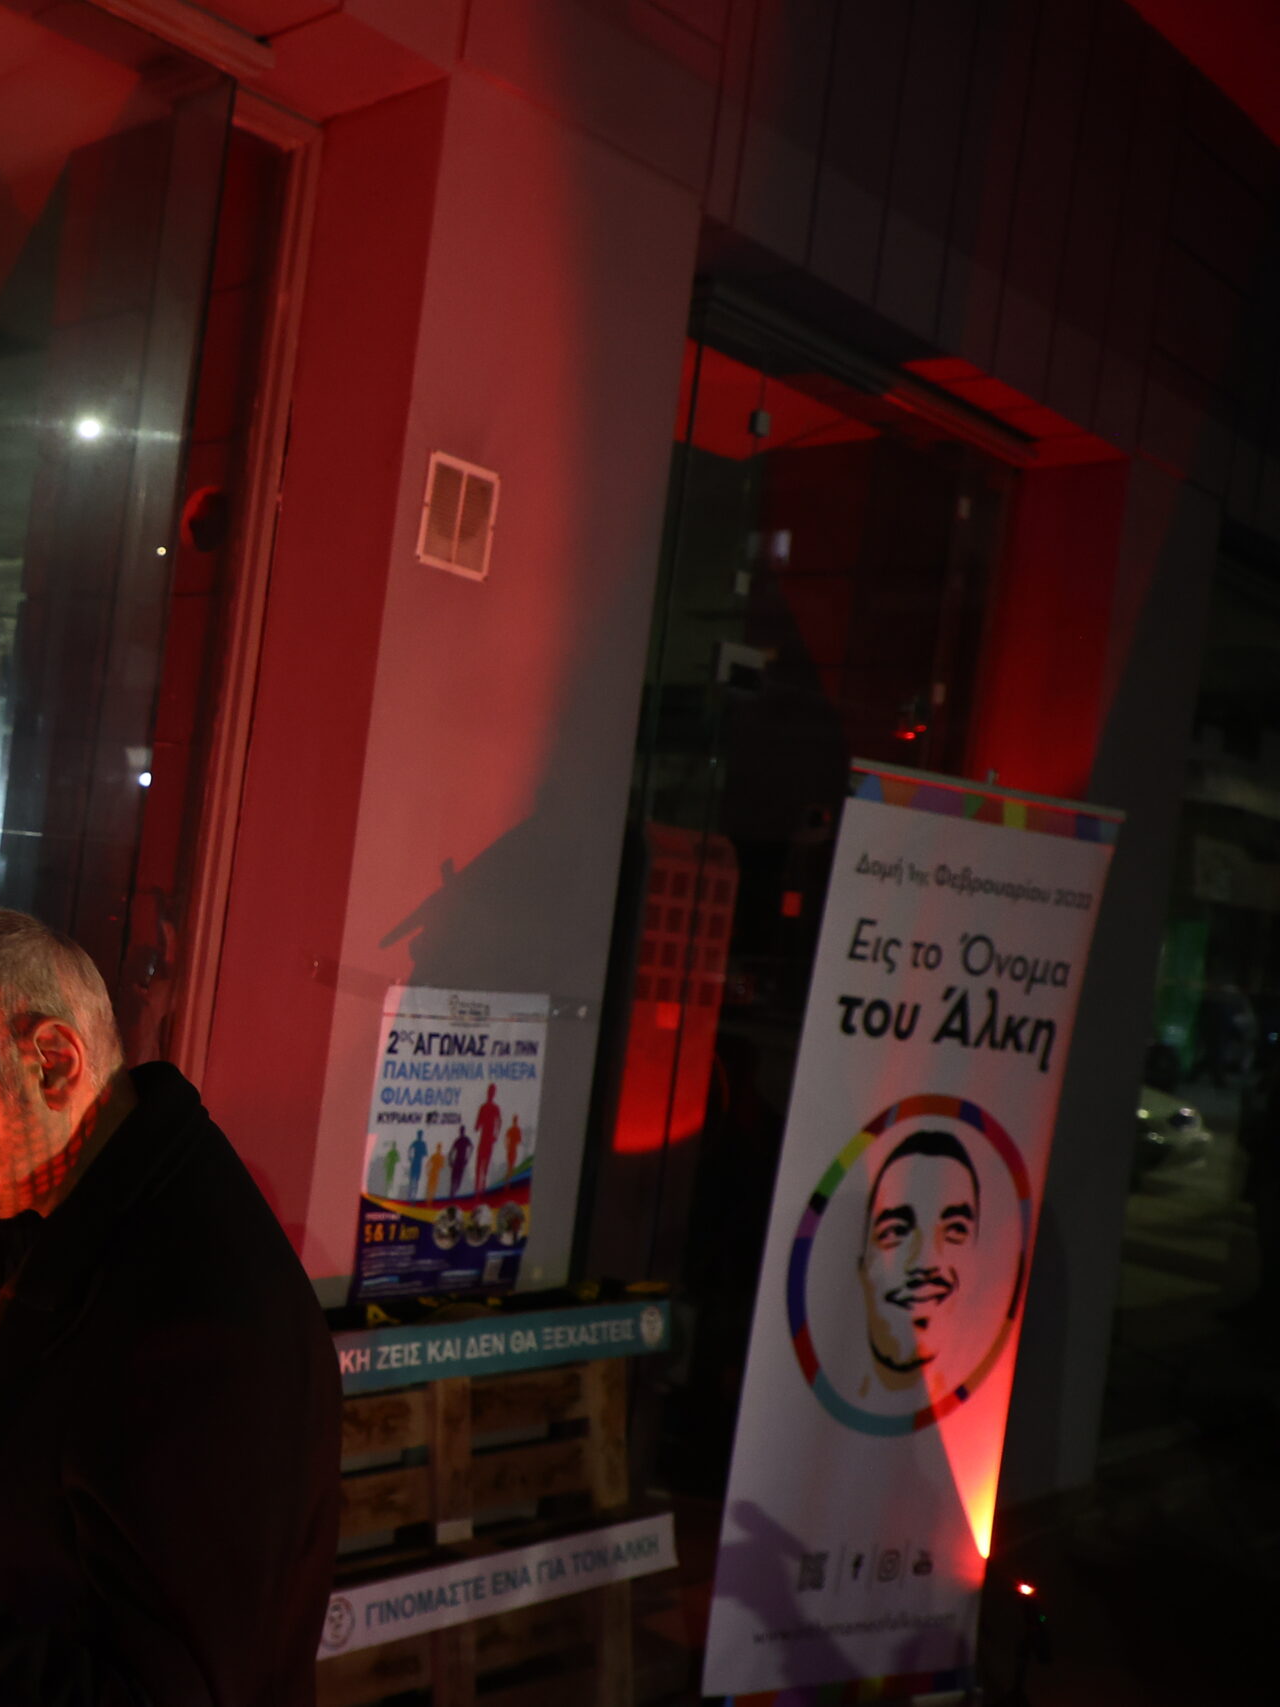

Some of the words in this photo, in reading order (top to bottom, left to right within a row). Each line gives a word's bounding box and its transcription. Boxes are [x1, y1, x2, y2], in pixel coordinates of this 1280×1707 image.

[855, 853, 903, 885] Δομή
[934, 864, 1051, 903] Φεβρουαρίου
[848, 917, 902, 974] Εις
[910, 941, 943, 970] το
[959, 932, 1071, 994] Όνομα
[413, 1032, 489, 1056] ΑΓΩΝΑΣ
[837, 995, 921, 1041] του
[932, 986, 1057, 1074] Άλκη
[383, 1060, 484, 1081] ΠΑΝΕΛΛΗΝΙΑ
[488, 1062, 537, 1081] ΗΜΕΡΑ
[376, 1342, 423, 1372] ΖΕΙΣ
[427, 1338, 462, 1363] ΚΑΙ
[465, 1333, 506, 1360] ΔΕΝ
[509, 1330, 538, 1354] ΘΑ
[542, 1318, 635, 1351] ΞΕΧΑΣΤΕΙΣ
[365, 1576, 487, 1627] ΓΙΝΟΜΑΣΤΕ
[491, 1566, 532, 1595] ΕΝΑ
[536, 1558, 567, 1584] ΓΙΑ
[572, 1548, 608, 1576] ΤΟΝ
[611, 1534, 660, 1564] ΑΛΚΗ
